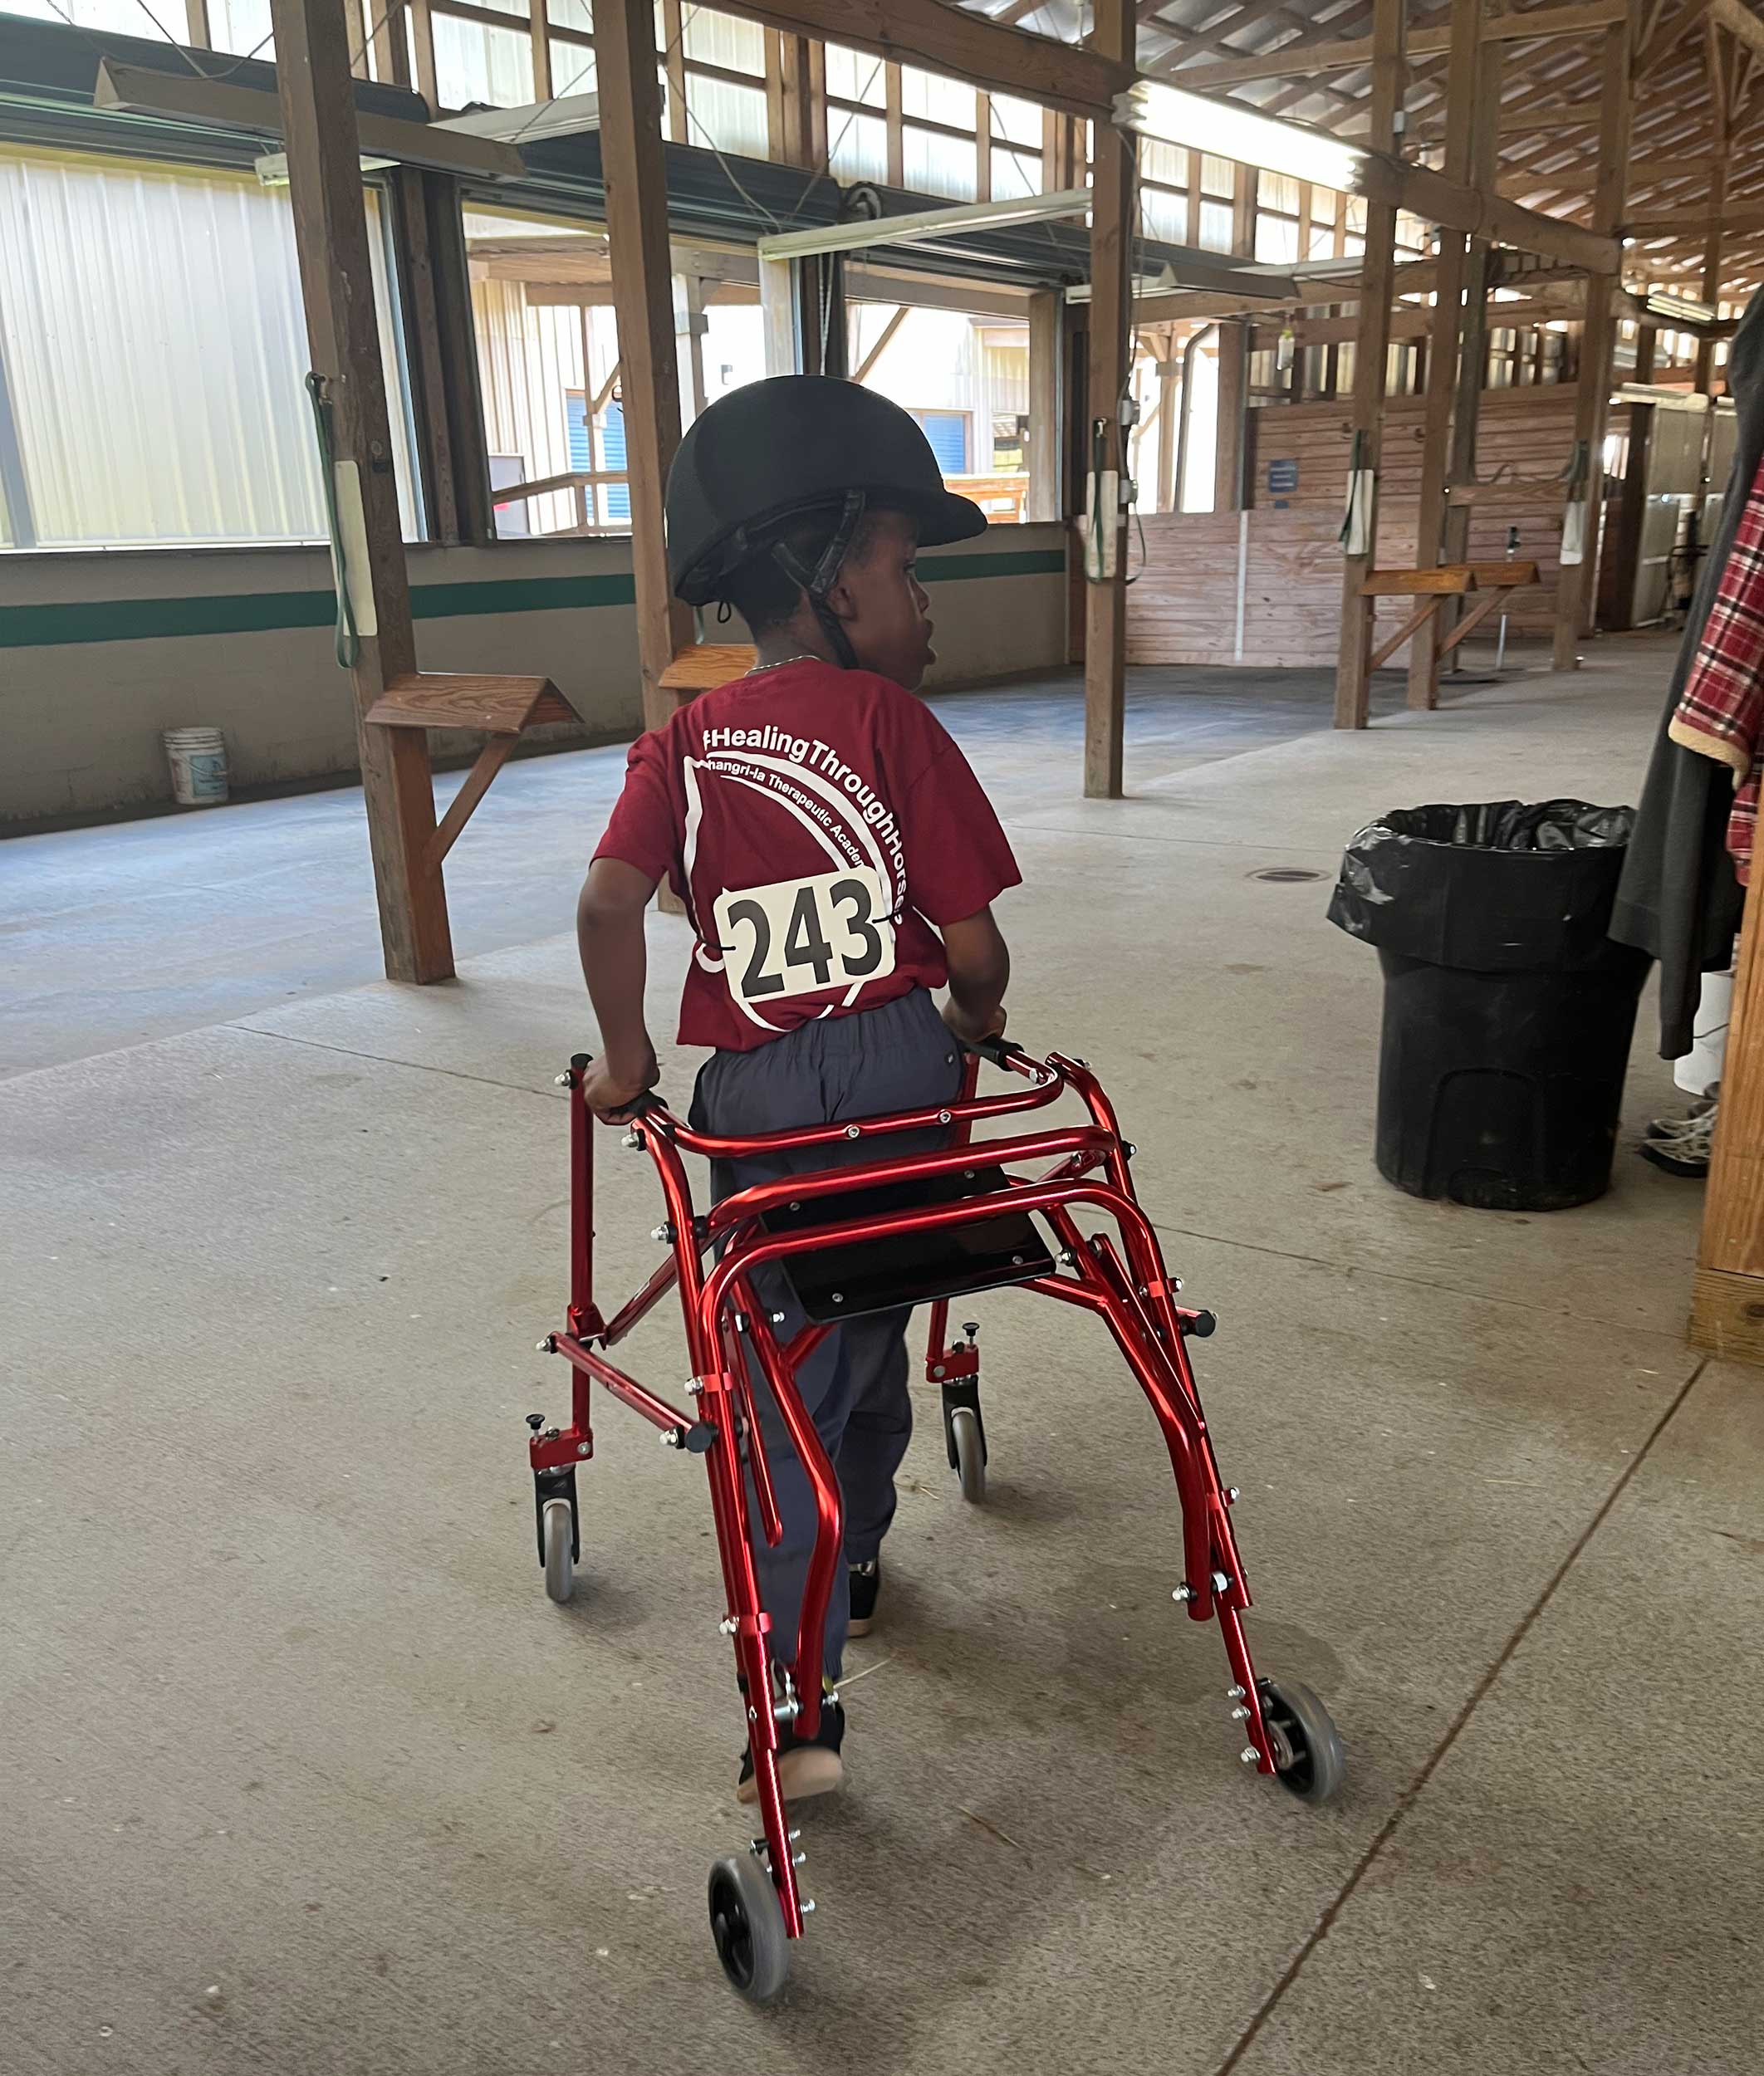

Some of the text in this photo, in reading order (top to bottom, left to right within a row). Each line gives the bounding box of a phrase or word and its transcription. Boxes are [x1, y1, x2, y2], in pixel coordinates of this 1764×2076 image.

[707, 760, 766, 782] hangri-la
[768, 774, 832, 826] Therapeutic
[727, 879, 883, 998] 243
